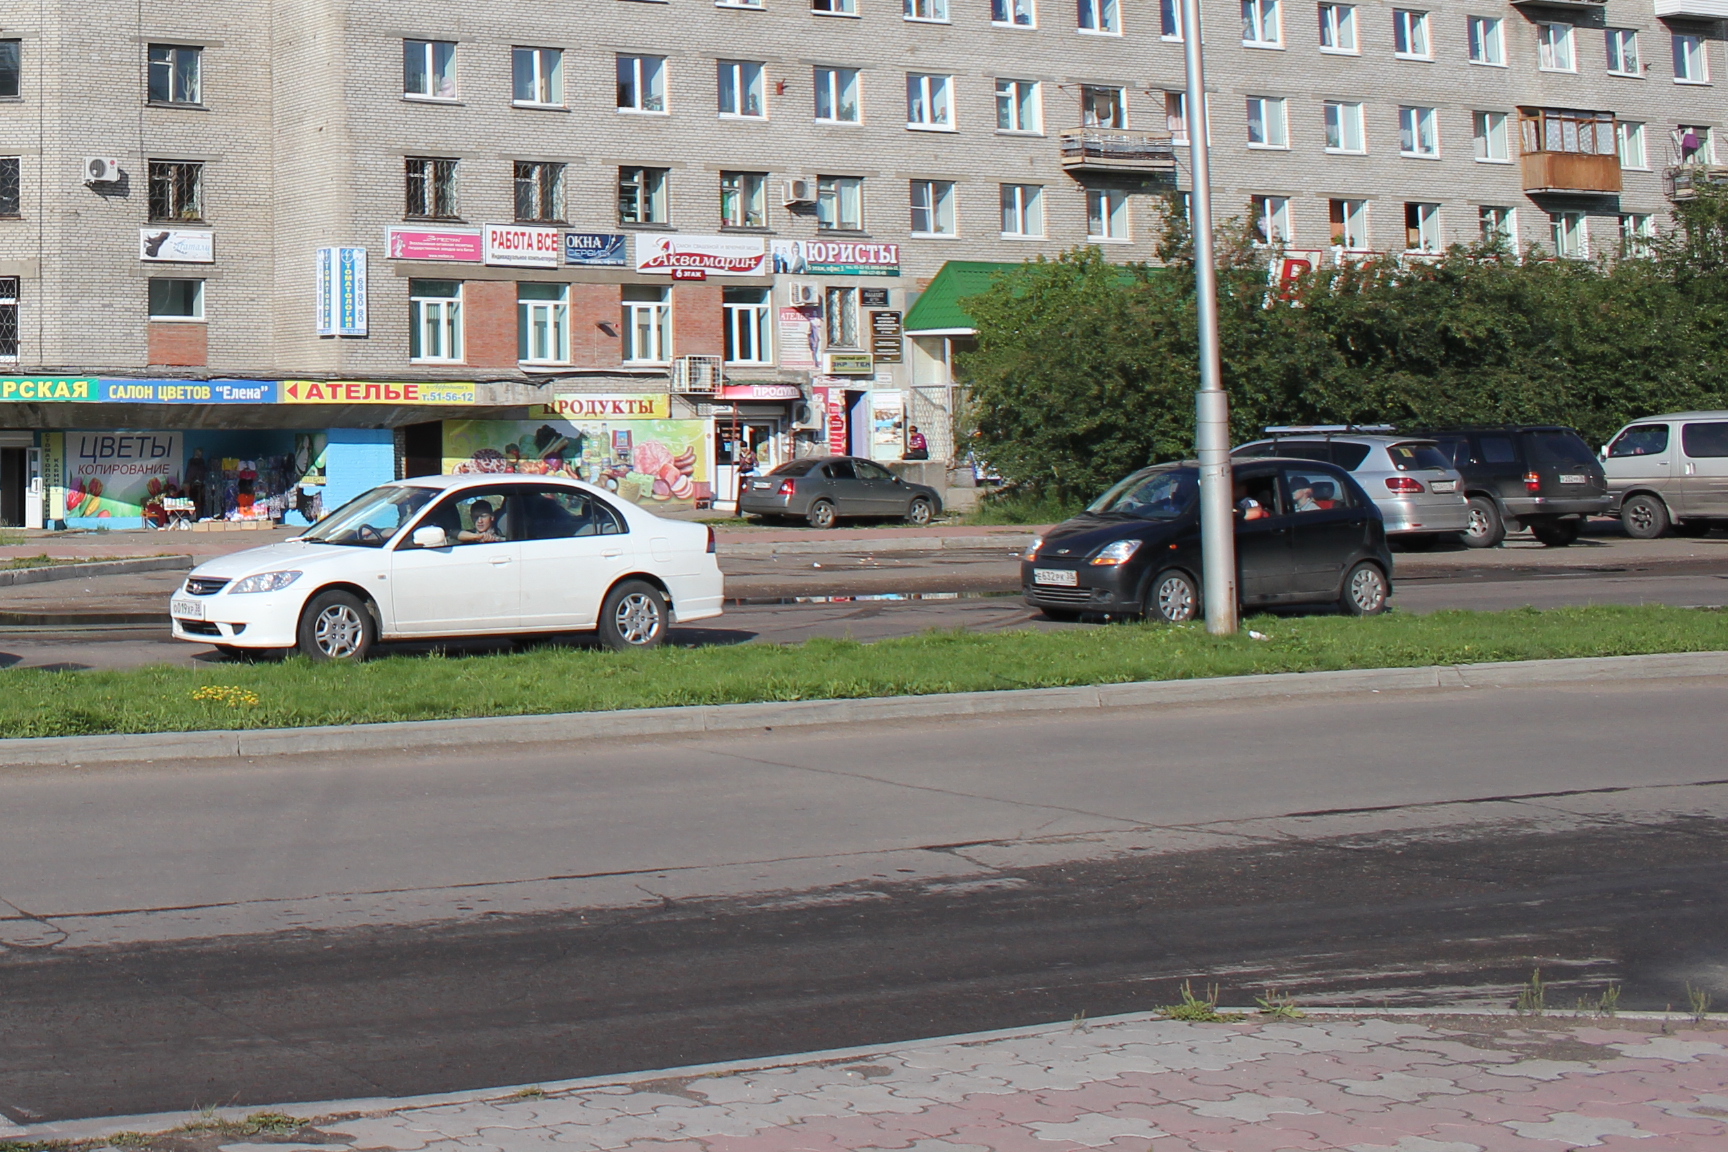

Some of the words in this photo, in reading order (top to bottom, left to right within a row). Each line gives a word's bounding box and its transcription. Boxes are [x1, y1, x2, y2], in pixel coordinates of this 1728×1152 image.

[491, 230, 532, 251] РАБОТА
[537, 233, 558, 252] ВСЕ
[566, 235, 602, 248] ОКНА
[649, 250, 757, 271] Аквамарин
[807, 243, 898, 264] ЮРИСТЫ
[676, 269, 682, 278] 6
[109, 385, 153, 399] САЛОН
[158, 386, 211, 401] ЦВЕТОВ
[305, 384, 419, 400] АТЕЛЬЕ
[422, 392, 473, 402] т.51-56-12
[543, 399, 654, 417] ПРОДУКТЫ
[79, 436, 173, 463] ЦВЕТЫ
[77, 464, 170, 475] КОПИРОВАНИЕ
